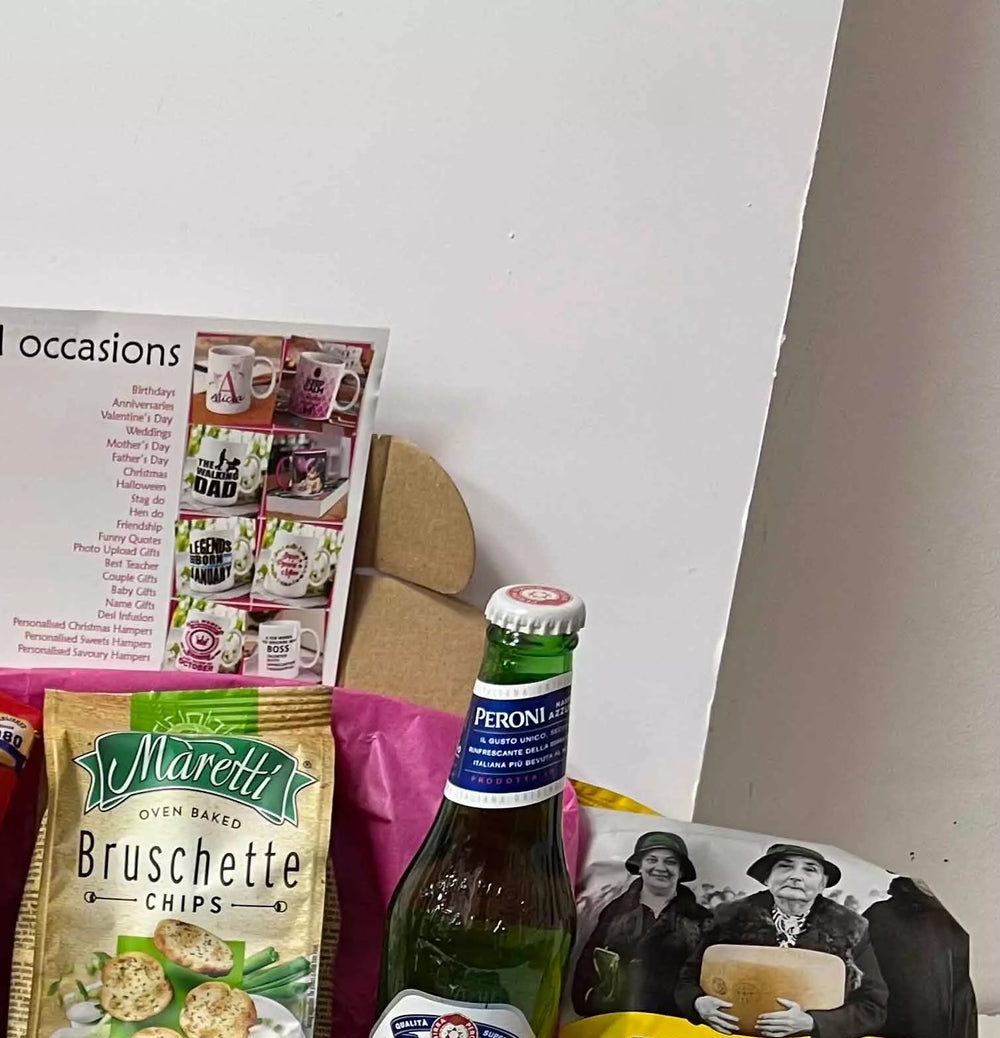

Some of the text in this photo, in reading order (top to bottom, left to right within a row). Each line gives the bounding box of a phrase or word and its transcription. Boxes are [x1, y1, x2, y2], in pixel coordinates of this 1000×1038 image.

[19, 332, 181, 368] occasions
[132, 385, 175, 400] Birthdays
[112, 398, 174, 411] Anniversaries
[154, 414, 173, 425] Day
[126, 426, 171, 440] Weddings
[152, 442, 170, 453] Day
[151, 455, 169, 467] Day
[123, 467, 167, 478] Christmas
[116, 480, 166, 491] Halloween
[193, 478, 237, 499] DAD
[131, 494, 165, 506] Stag do
[130, 507, 164, 518] Hen do
[117, 520, 163, 532] Friendship
[99, 532, 161, 545] Funny Quotes
[73, 543, 160, 557] Photo Upload Gifts
[189, 537, 232, 554] LEGENDS
[105, 558, 159, 570] Best Teacher
[102, 572, 157, 583] Couple Gifts
[190, 565, 231, 586] JANUARY
[111, 585, 156, 597] Baby Gifts
[105, 599, 155, 610] Name Gifts
[119, 612, 154, 622] Infusion
[13, 617, 152, 636] Personalised Christmas Hampers
[25, 631, 151, 649] Personalised Sweets Hampers
[18, 644, 150, 662] Personalised Savoury Hampers
[266, 645, 289, 653] BOSS
[474, 707, 546, 728] PERONI
[107, 734, 282, 801] Maretti
[138, 806, 242, 830] OVEN BAKED
[78, 830, 300, 889] Bruschette
[145, 892, 222, 914] CHIPS
